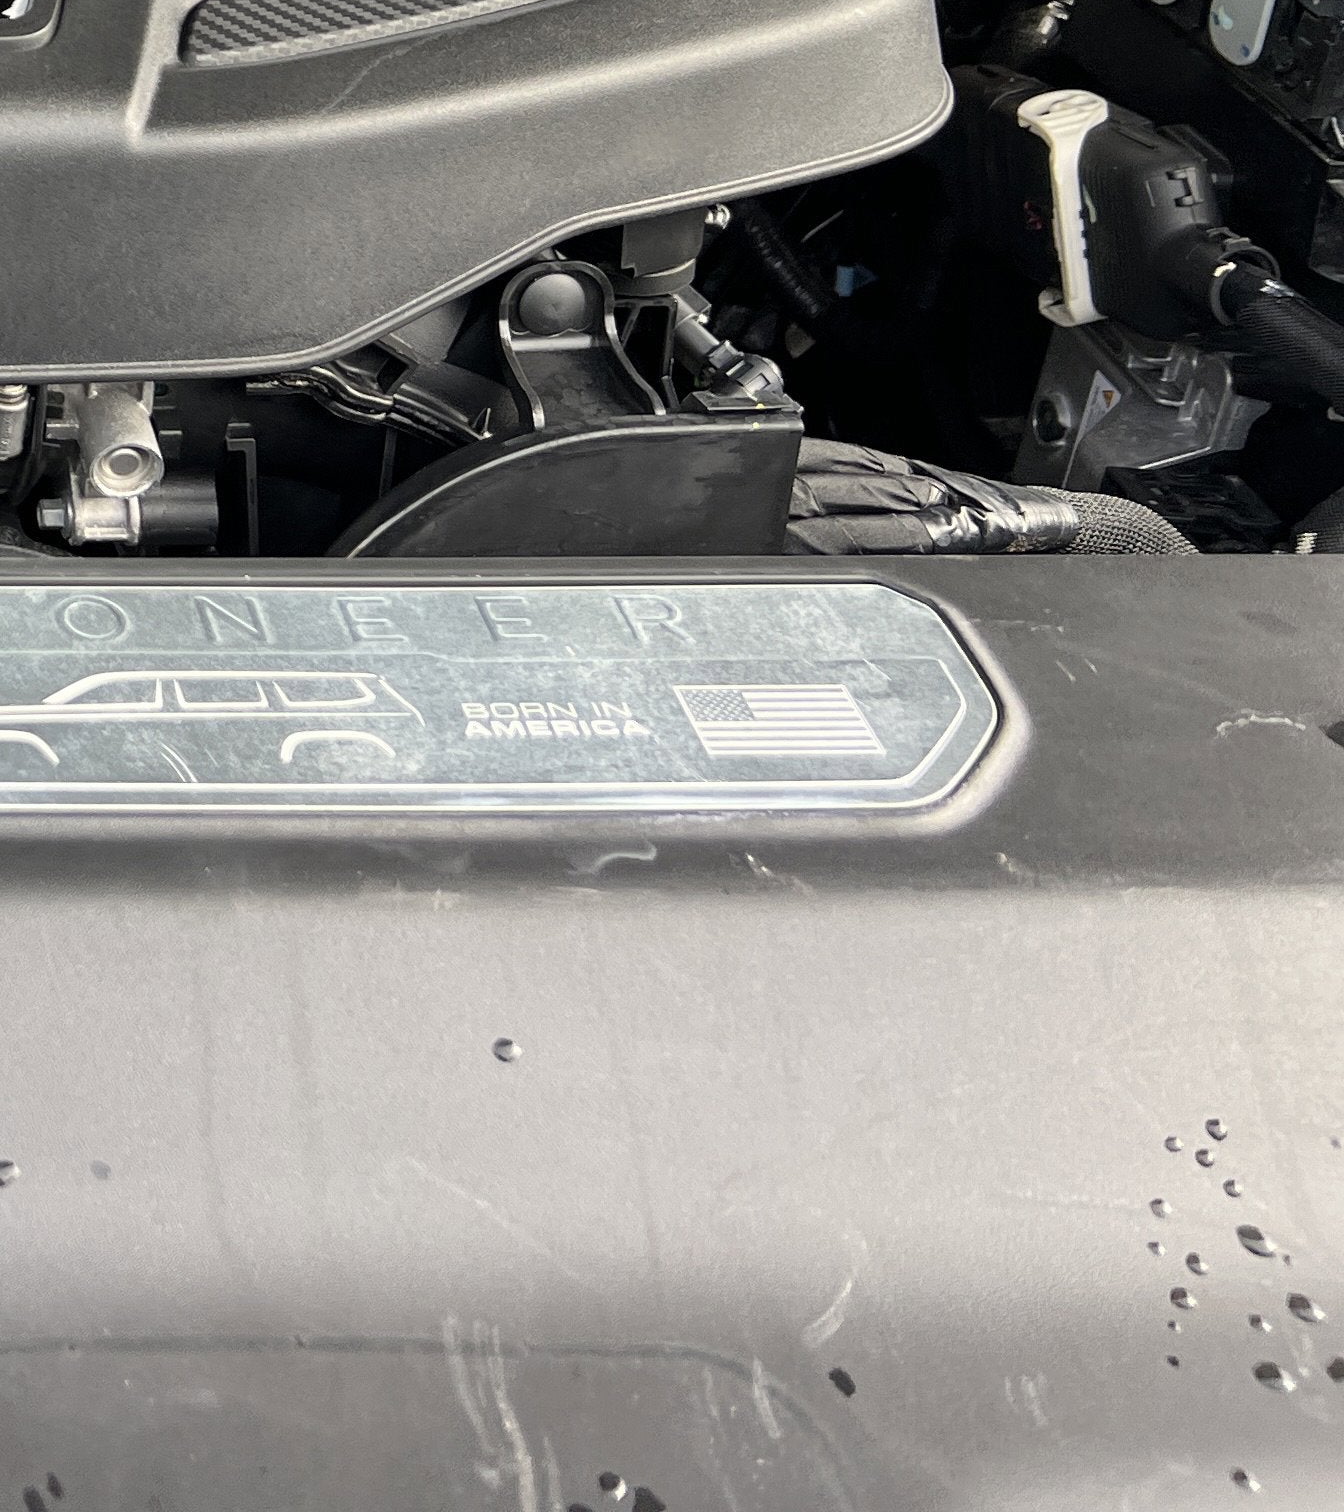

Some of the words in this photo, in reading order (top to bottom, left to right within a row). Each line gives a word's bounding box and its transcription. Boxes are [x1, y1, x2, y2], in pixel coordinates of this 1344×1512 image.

[461, 701, 579, 720] BORN
[591, 701, 633, 719] IN
[464, 719, 652, 739] AMERICA
